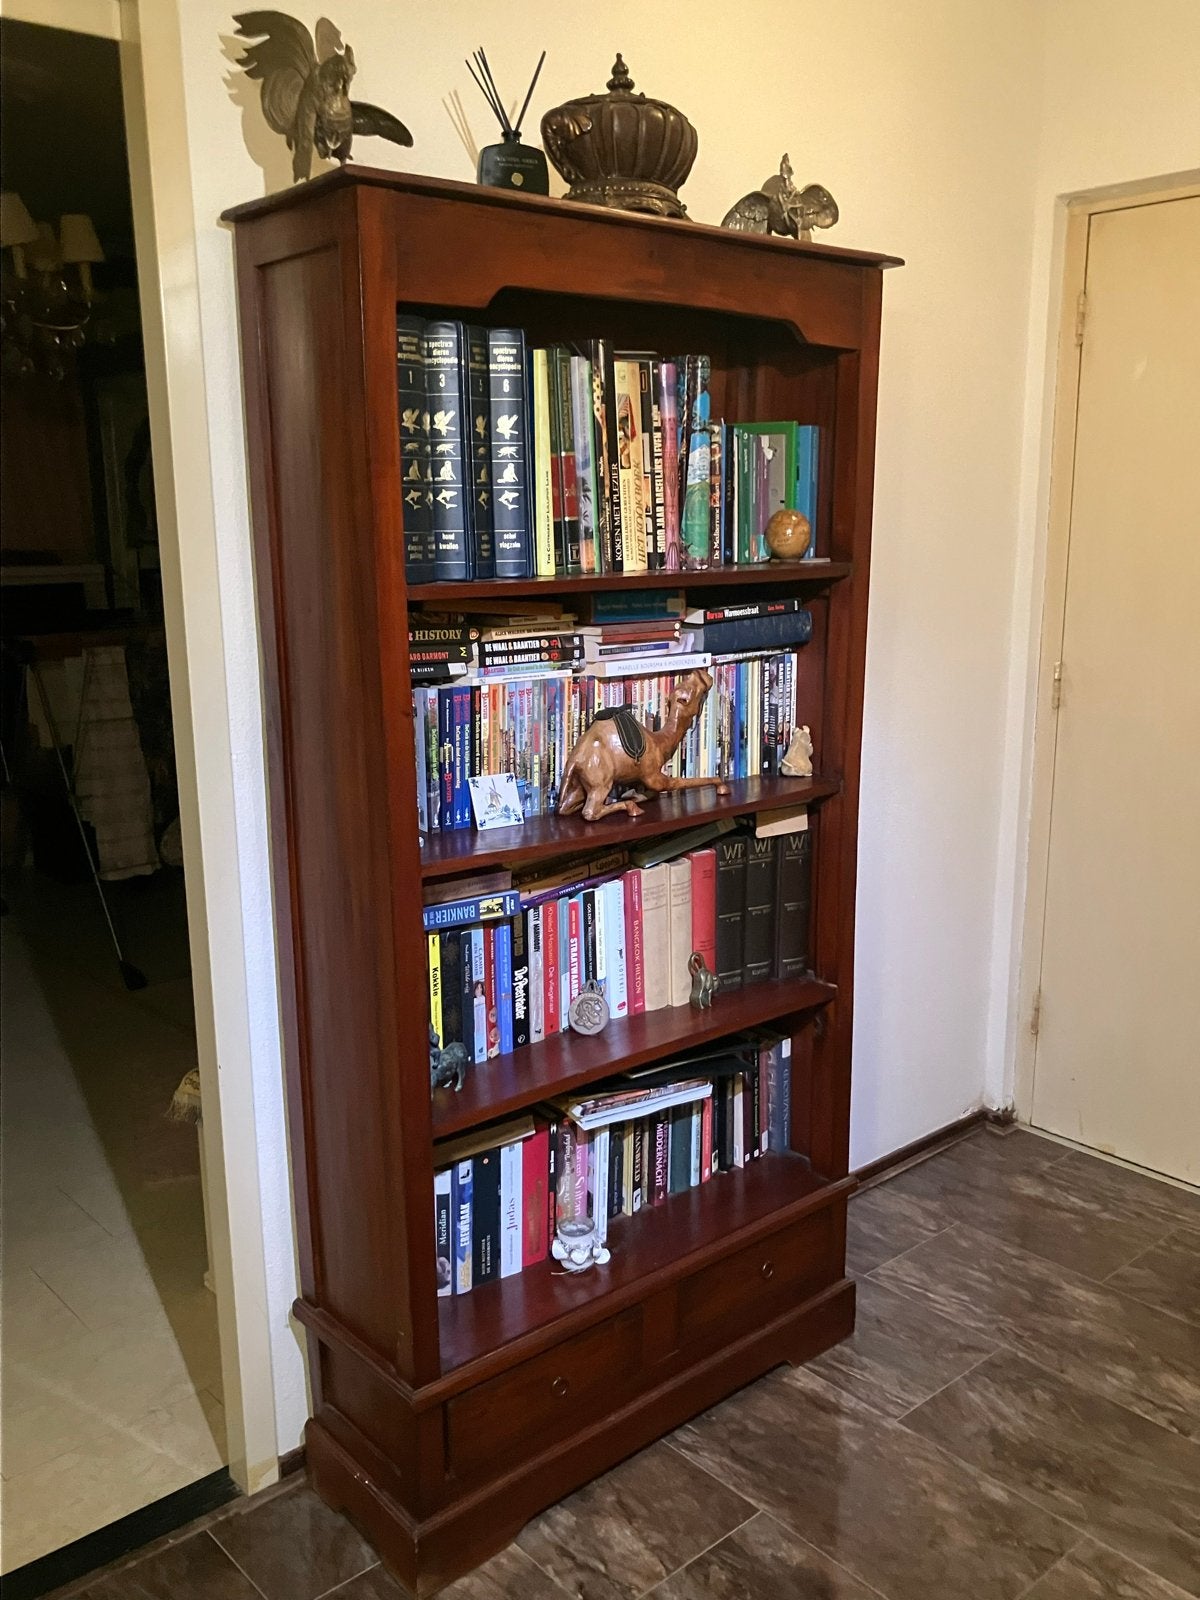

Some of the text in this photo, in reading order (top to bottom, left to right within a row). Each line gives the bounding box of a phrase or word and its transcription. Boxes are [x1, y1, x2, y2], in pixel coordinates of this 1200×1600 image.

[440, 374, 445, 387] 3
[503, 379, 509, 392] 6
[611, 463, 619, 502] PLEZIER
[653, 432, 665, 552] 5000 JAAR DAGELIJKS LEVEN
[415, 629, 462, 640] HISTORY
[484, 643, 492, 652] DE
[492, 641, 508, 651] WAAL
[508, 641, 513, 650] &
[485, 657, 492, 665] DE
[493, 655, 508, 665] WAAL
[508, 655, 513, 663] &
[436, 905, 475, 922] BANKIER
[548, 966, 554, 978] De
[570, 938, 578, 1000] STRAATWAARDE
[512, 966, 528, 1020] De Peetvader
[460, 1202, 470, 1247] EREWRAAK
[506, 1197, 517, 1230] Judas
[439, 1209, 447, 1245] Meridian
